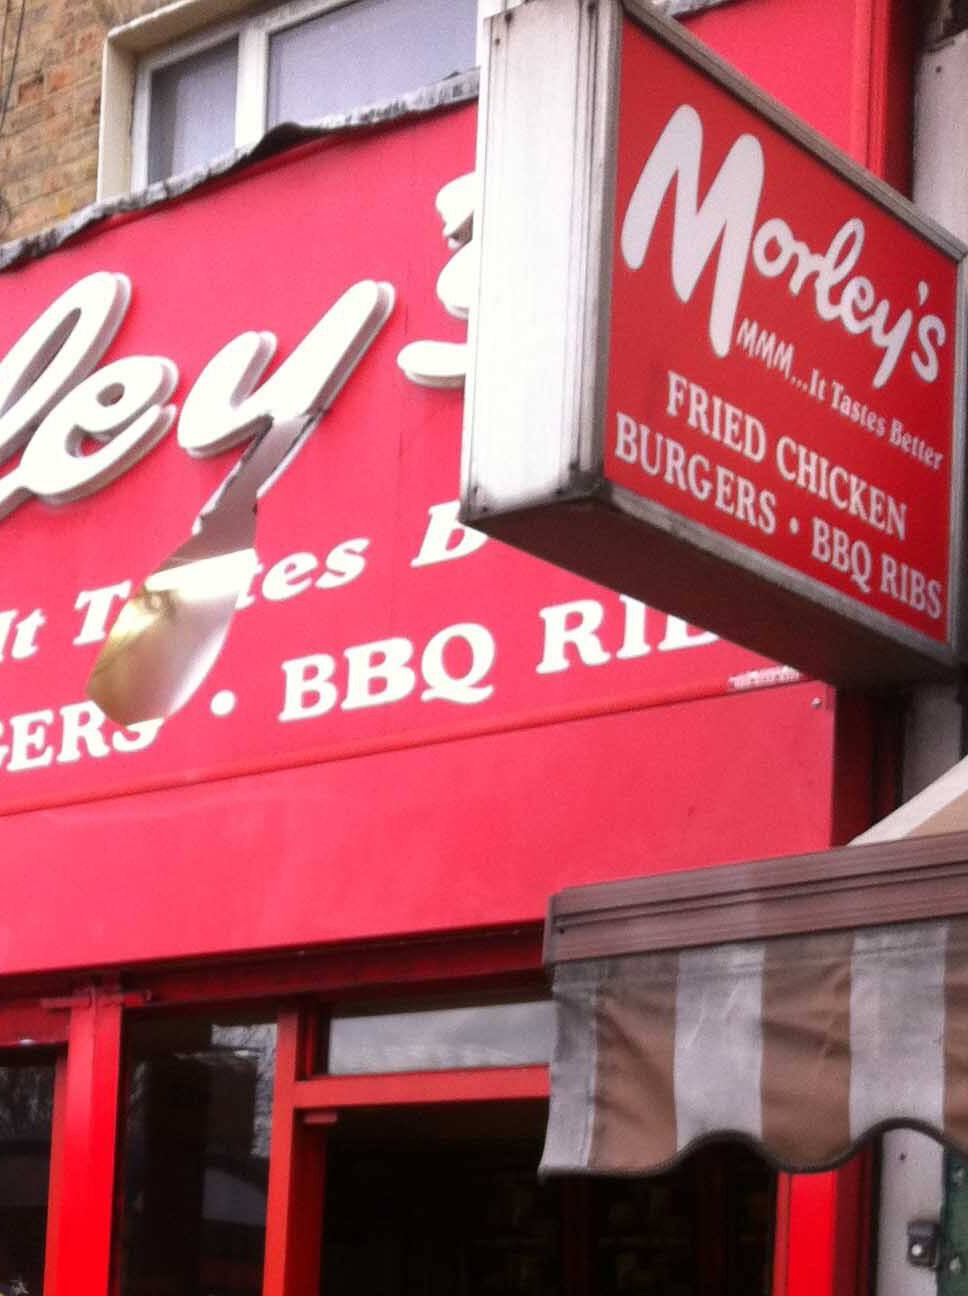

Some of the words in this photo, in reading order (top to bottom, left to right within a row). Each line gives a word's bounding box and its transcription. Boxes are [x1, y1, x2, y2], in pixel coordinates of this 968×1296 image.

[621, 104, 946, 388] Morley's
[667, 370, 766, 463] FRIED
[776, 436, 907, 541] CHICKEN
[831, 382, 886, 437] Tastes
[889, 419, 943, 471] Better
[615, 412, 777, 535] BURGERS
[812, 517, 871, 593] BBQ
[881, 554, 942, 619] RIBS
[278, 623, 495, 722] BBQ
[536, 594, 719, 674] RI
